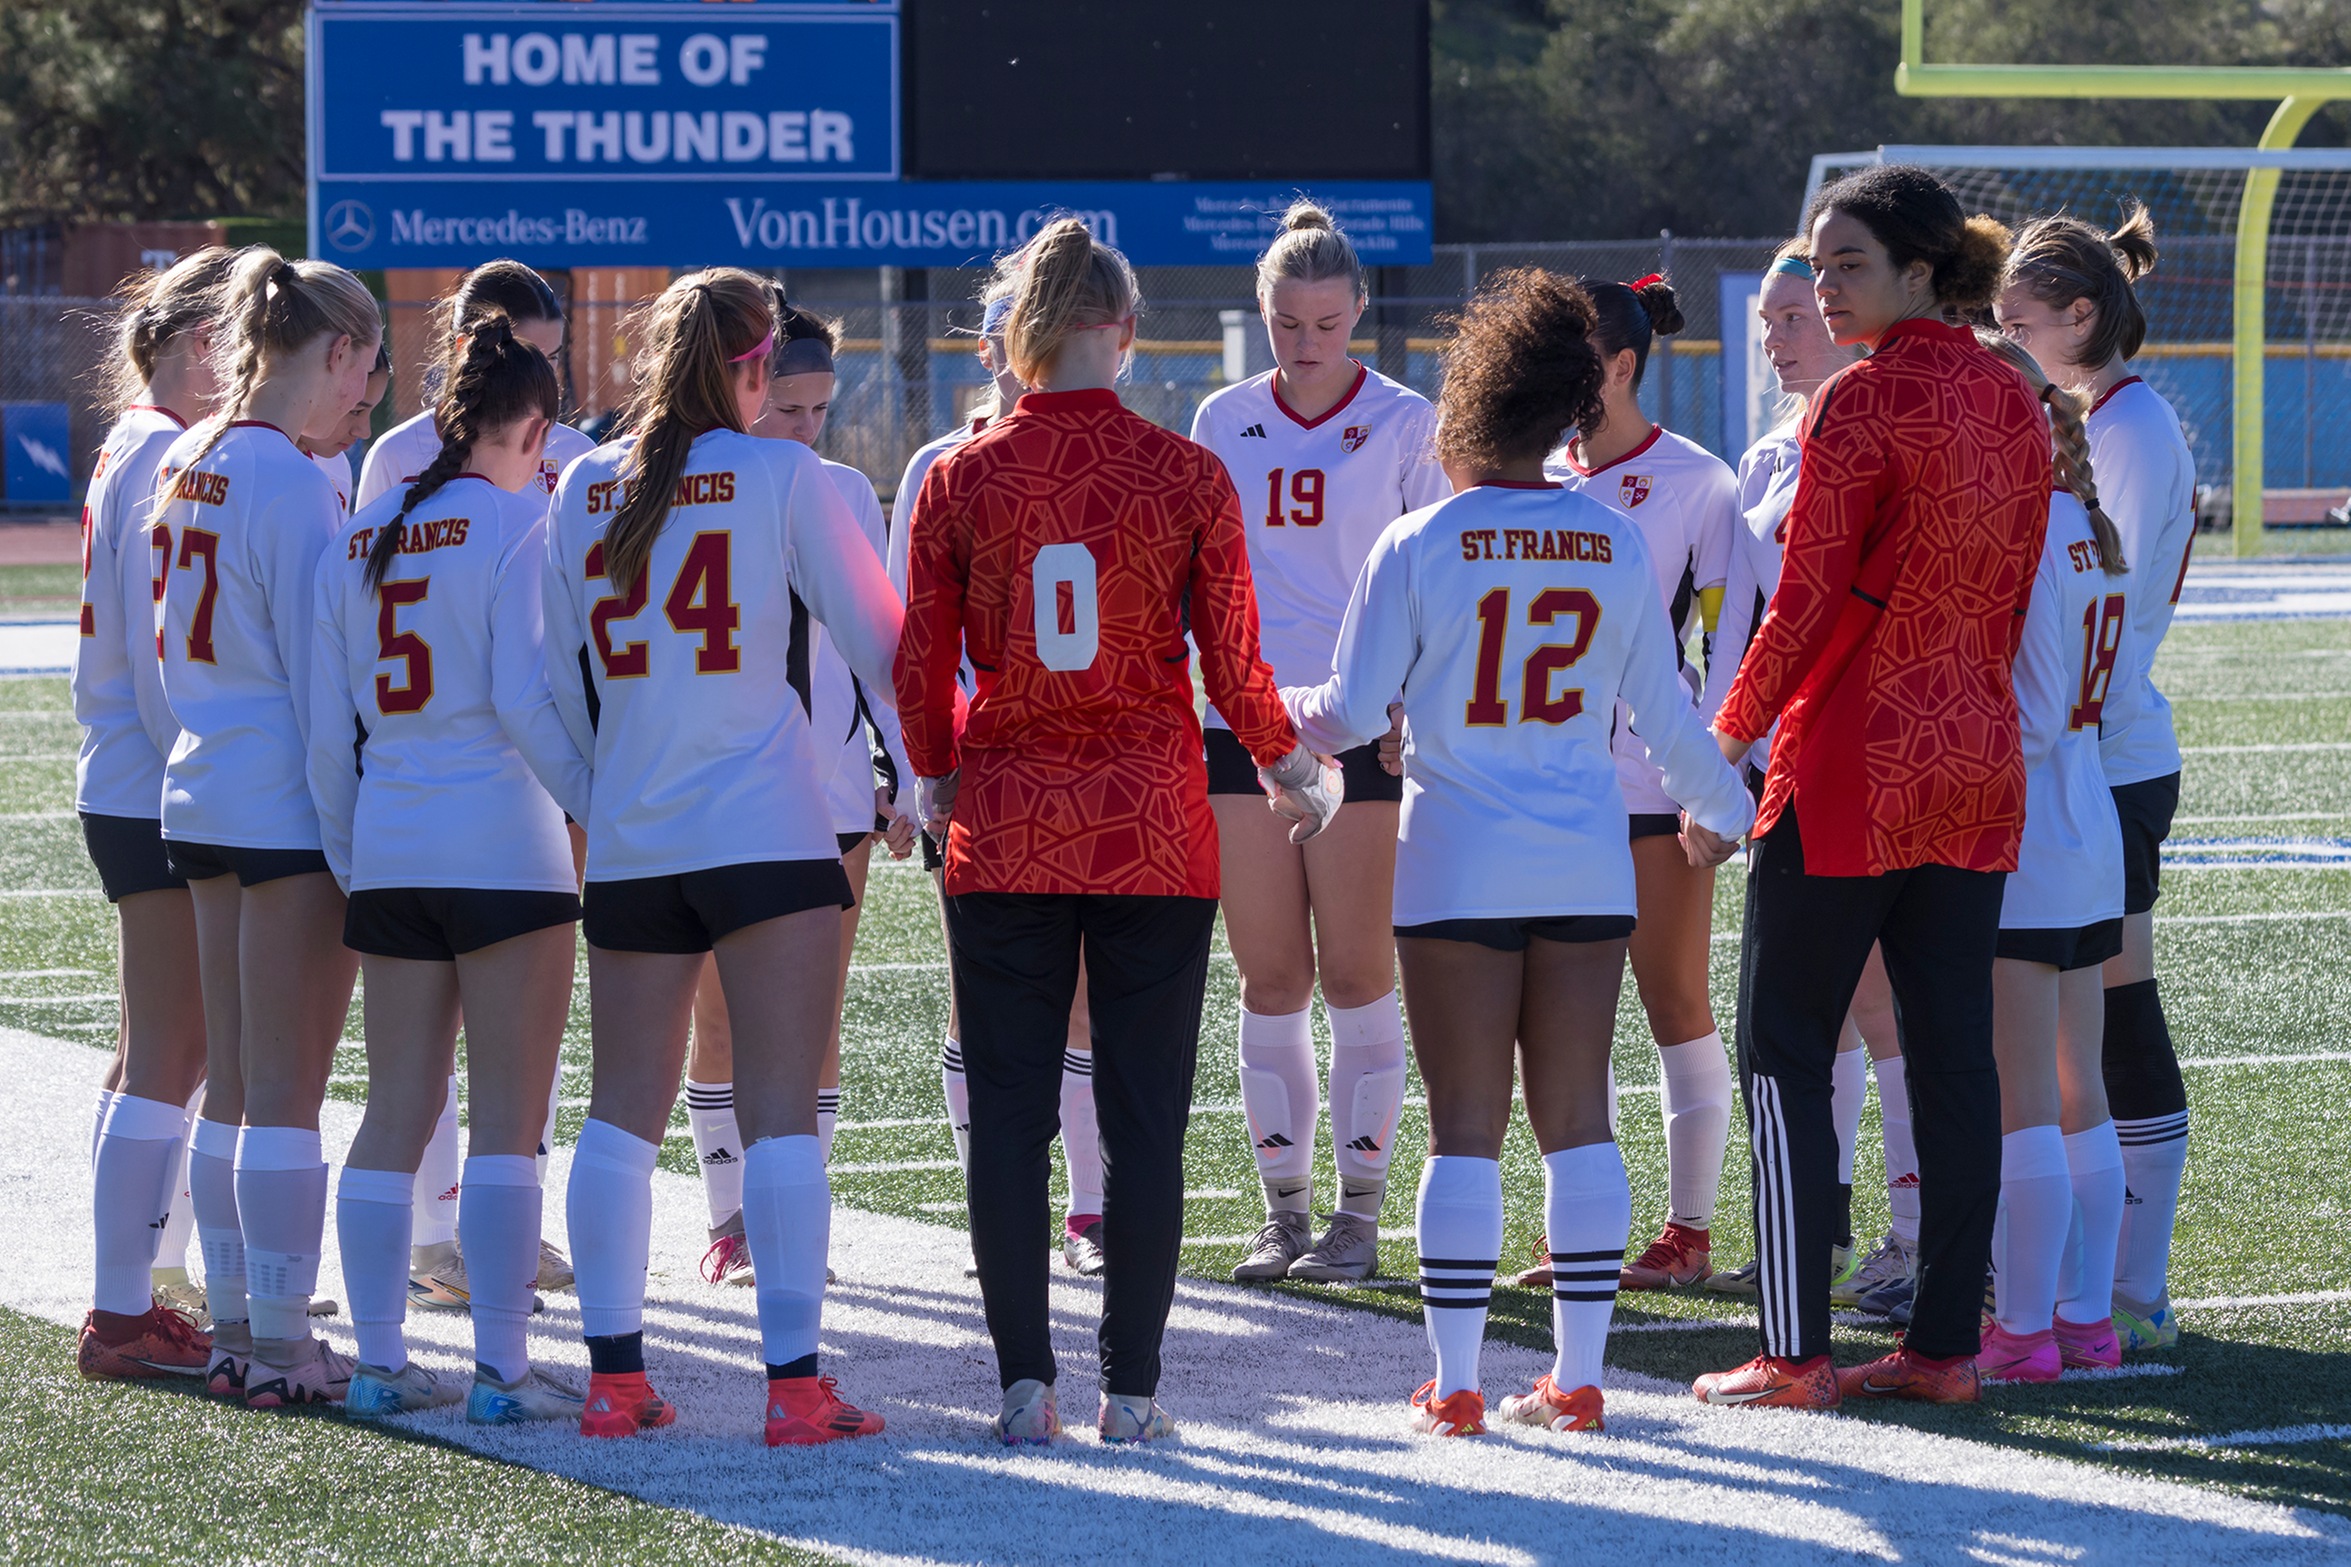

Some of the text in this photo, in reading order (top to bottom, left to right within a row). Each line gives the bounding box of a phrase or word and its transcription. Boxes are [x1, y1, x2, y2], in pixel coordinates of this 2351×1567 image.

[463, 34, 767, 86] HOME OF
[381, 110, 854, 163] THE THUNDER
[391, 209, 648, 245] Mercedes-Benz
[726, 198, 1119, 249] VonHousen.cm
[1265, 467, 1326, 528] 19
[584, 529, 741, 680] 24
[1032, 542, 1099, 672] 0
[375, 575, 435, 717] 5
[1465, 586, 1603, 728] 12
